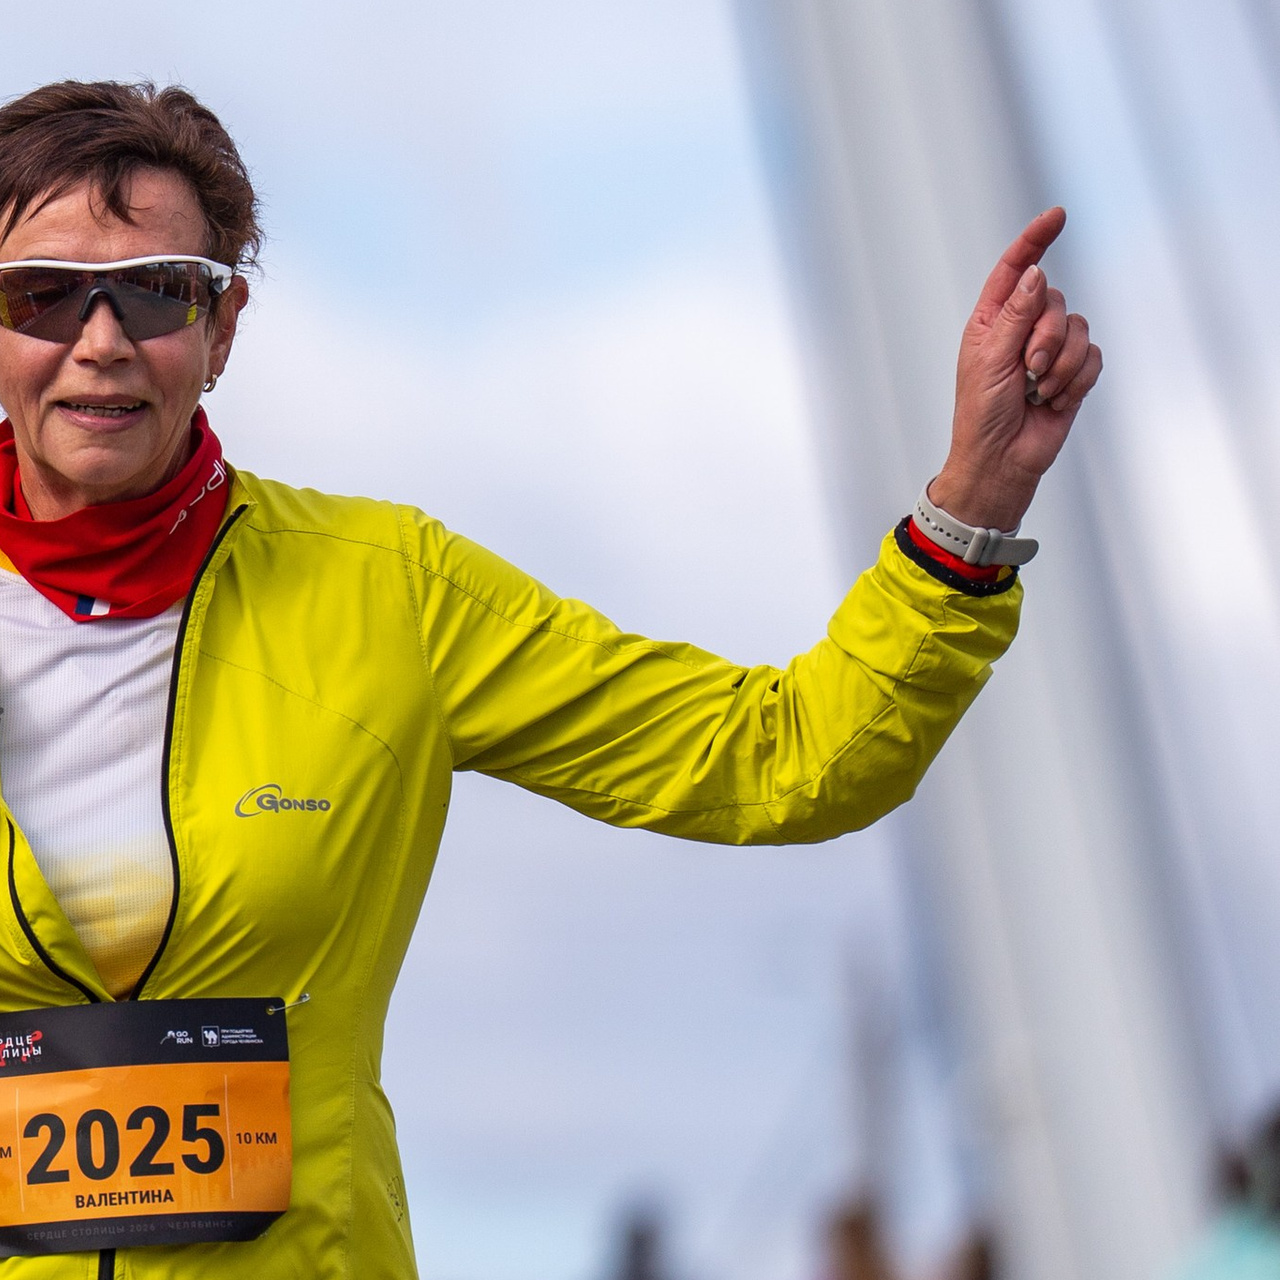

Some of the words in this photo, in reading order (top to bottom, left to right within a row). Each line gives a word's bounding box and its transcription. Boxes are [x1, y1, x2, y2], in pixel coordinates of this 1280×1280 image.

[23, 1104, 225, 1186] 2025
[236, 1132, 252, 1145] 10
[75, 1189, 175, 1209] ВАЛЕНТИНА
[27, 1231, 68, 1241] СЕРДЦЕ
[71, 1226, 125, 1237] СТОЛИЦЫ
[129, 1223, 156, 1233] 2026
[168, 1221, 234, 1230] ЧЕЛЯБИНСК
